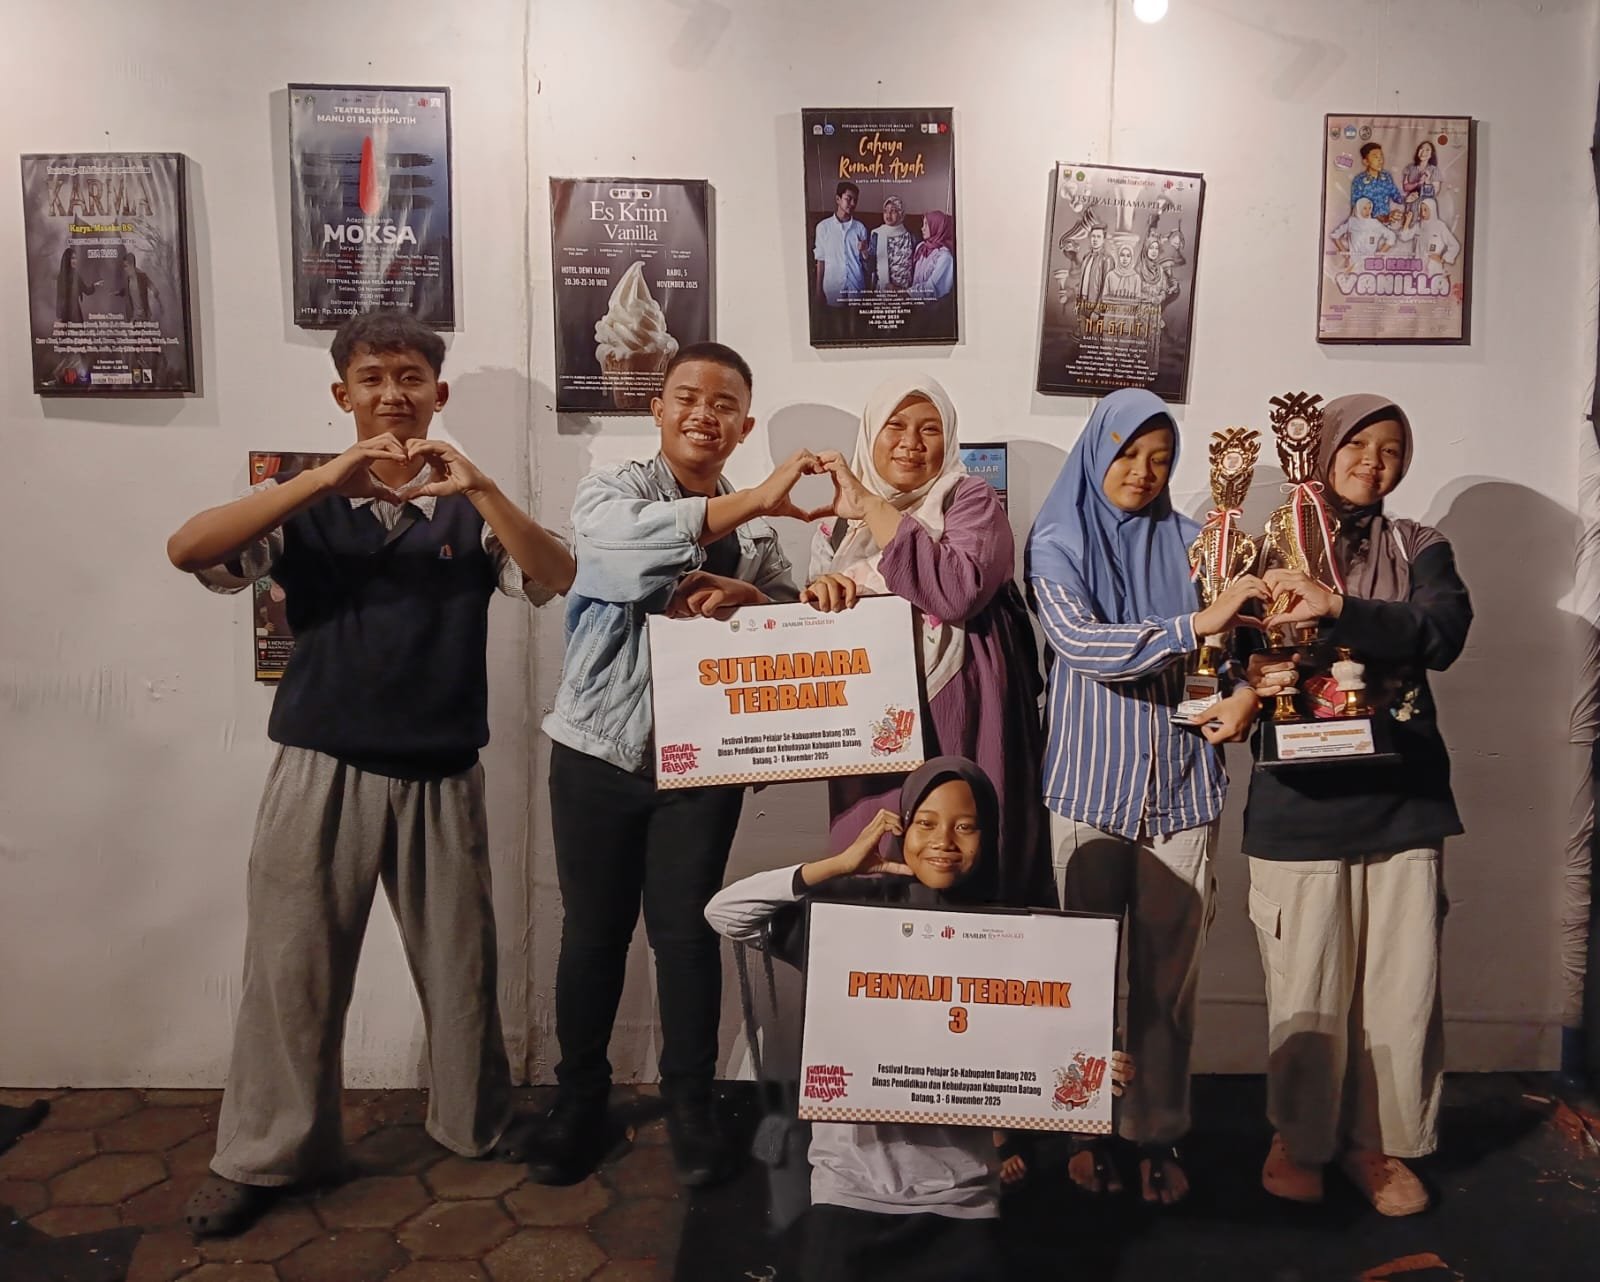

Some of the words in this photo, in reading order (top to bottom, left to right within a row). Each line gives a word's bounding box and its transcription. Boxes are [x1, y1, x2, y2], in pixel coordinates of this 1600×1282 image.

[317, 114, 344, 122] MANU
[359, 115, 416, 124] BANYUPUTIH
[334, 106, 365, 114] TEATER
[366, 107, 399, 115] SESAMA
[860, 132, 903, 156] Cahaya
[839, 154, 884, 178] Rumah
[889, 154, 925, 180] Ayah
[47, 179, 153, 217] KARMA
[1114, 199, 1146, 209] DRAMA
[589, 201, 614, 221] Es
[619, 202, 669, 222] Krim
[324, 224, 417, 244] MOKSA
[603, 224, 658, 241] Vanilla
[656, 280, 684, 288] NOVEMBER
[1335, 272, 1451, 297] VANILLA
[1086, 319, 1149, 337] NASTITI
[698, 648, 871, 685] SUTRADARA
[725, 680, 848, 714] TERBAIK
[721, 735, 743, 745] Festival
[744, 735, 762, 744] Drama
[763, 733, 782, 743] Pelajar
[783, 731, 821, 742] Se-Kabupaten
[822, 729, 841, 739] Batang
[842, 728, 856, 736] 2025
[717, 748, 734, 757] Dinas
[734, 746, 765, 755] Pendidikan
[766, 744, 776, 752] dan
[778, 743, 811, 753] Kebudayaan
[812, 741, 841, 751] Kabupaten
[842, 739, 861, 748] Batang
[786, 753, 814, 762] November
[814, 752, 829, 760] 2025
[848, 971, 952, 1002] PENYAJI
[957, 976, 1072, 1008] TERBAIK
[948, 1006, 968, 1034] 3
[878, 1063, 903, 1074] Festival
[904, 1065, 925, 1075] Drama
[926, 1066, 949, 1077] Pelajar
[950, 1067, 995, 1080] Se-Kabupaten
[996, 1070, 1019, 1082] Batang
[1020, 1071, 1037, 1081] 2025
[872, 1077, 891, 1087] Dinas
[891, 1078, 928, 1089] Pendidikan
[929, 1080, 941, 1089] dan
[942, 1081, 982, 1093] Kebudayaan
[982, 1082, 1018, 1094] Kabupaten
[1018, 1084, 1042, 1096] Batang
[937, 1094, 941, 1103] 3
[945, 1094, 950, 1104] 6
[951, 1095, 984, 1105] November
[985, 1096, 1001, 1106] 2025
